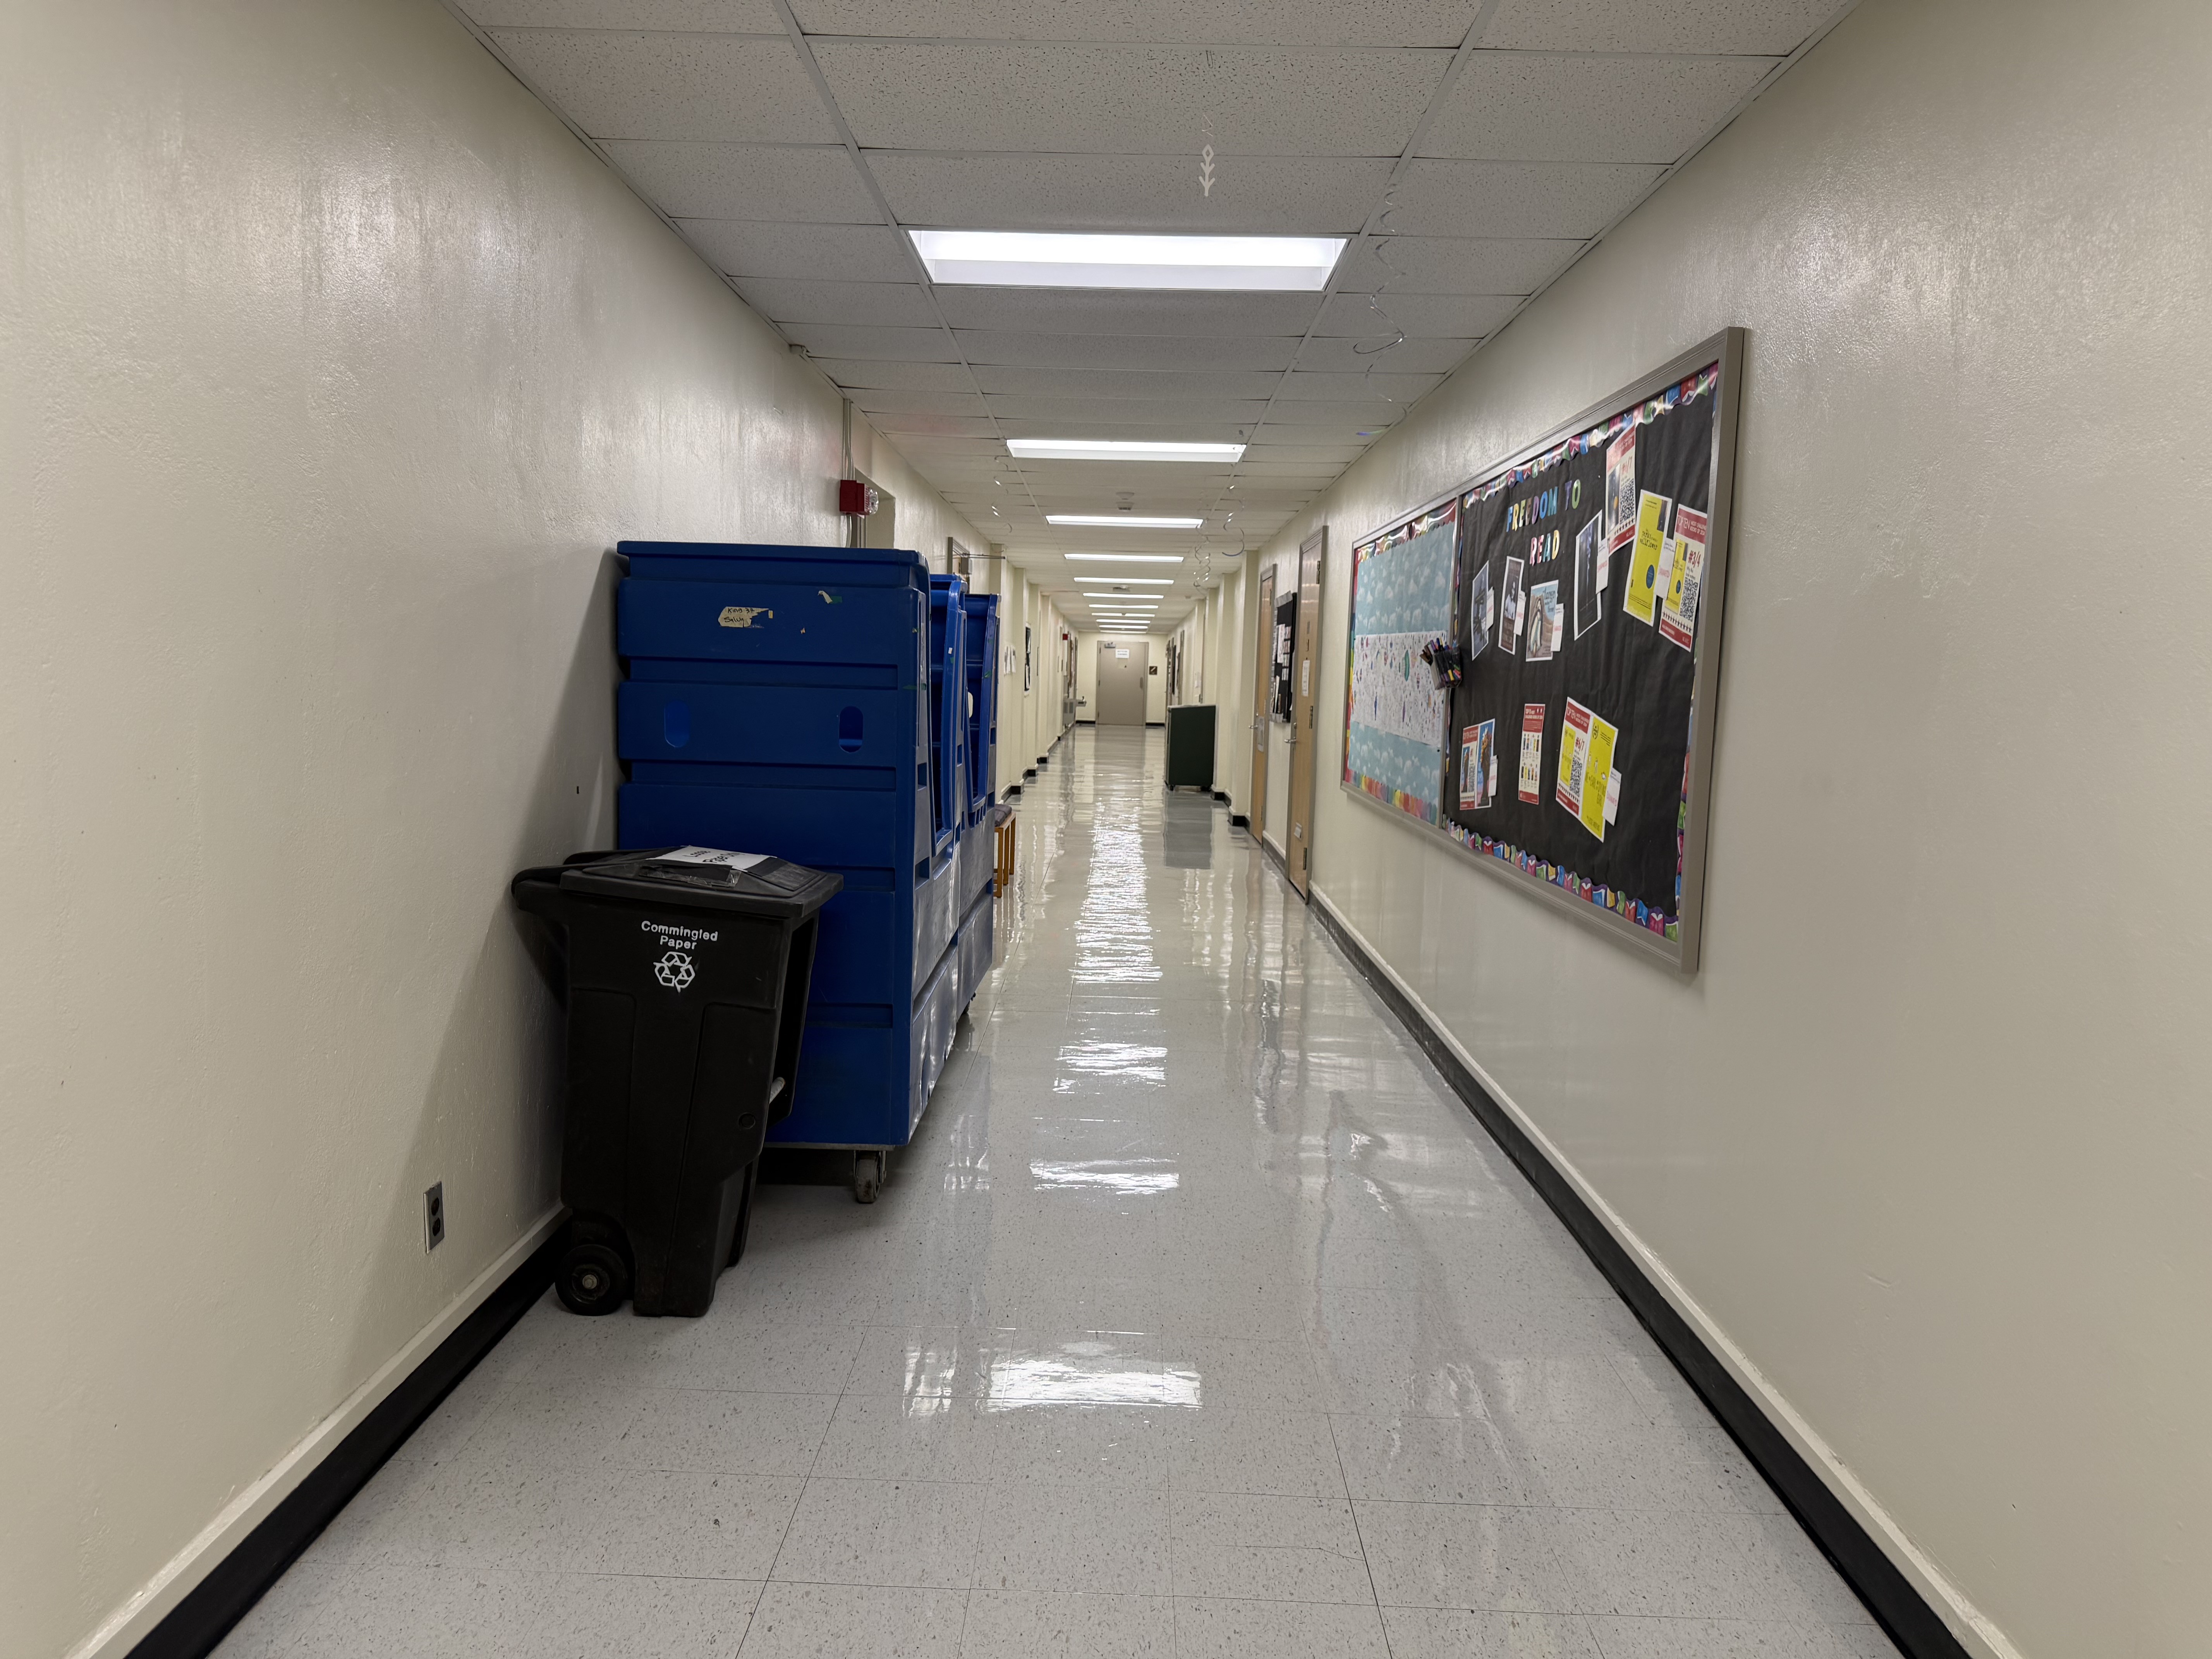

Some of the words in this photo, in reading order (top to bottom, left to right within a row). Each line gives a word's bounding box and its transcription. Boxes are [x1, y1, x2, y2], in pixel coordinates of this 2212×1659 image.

[1506, 486, 1558, 532] FREEDOM
[1565, 479, 1581, 511] TO
[1530, 530, 1560, 567] READ
[1688, 550, 1701, 568] #3/4
[641, 921, 718, 941] Commingled
[660, 935, 697, 950] Paper
